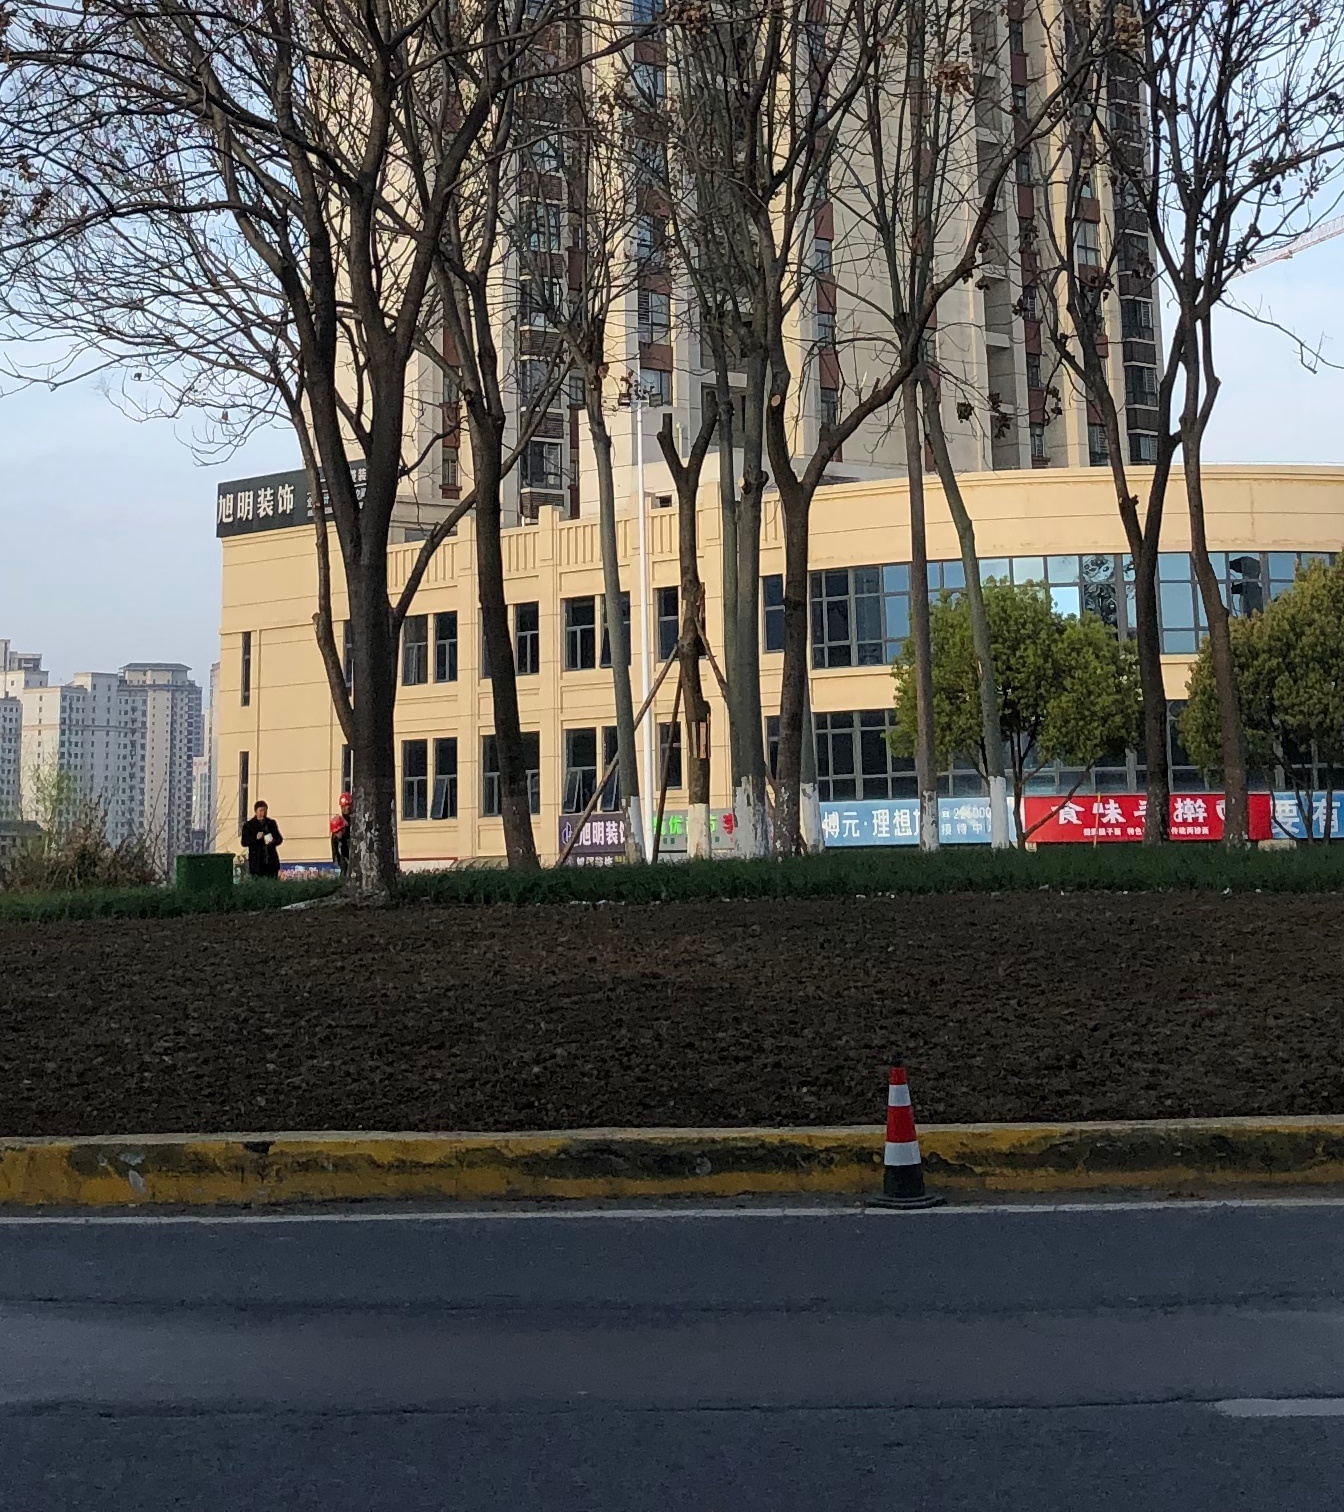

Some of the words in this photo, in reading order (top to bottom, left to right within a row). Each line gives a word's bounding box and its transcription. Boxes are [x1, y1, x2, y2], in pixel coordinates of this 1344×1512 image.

[217, 483, 296, 524] 旭明装饰
[821, 808, 920, 838] 博元·理想
[1050, 797, 1226, 825] 食味擀
[941, 823, 991, 835] 接待中
